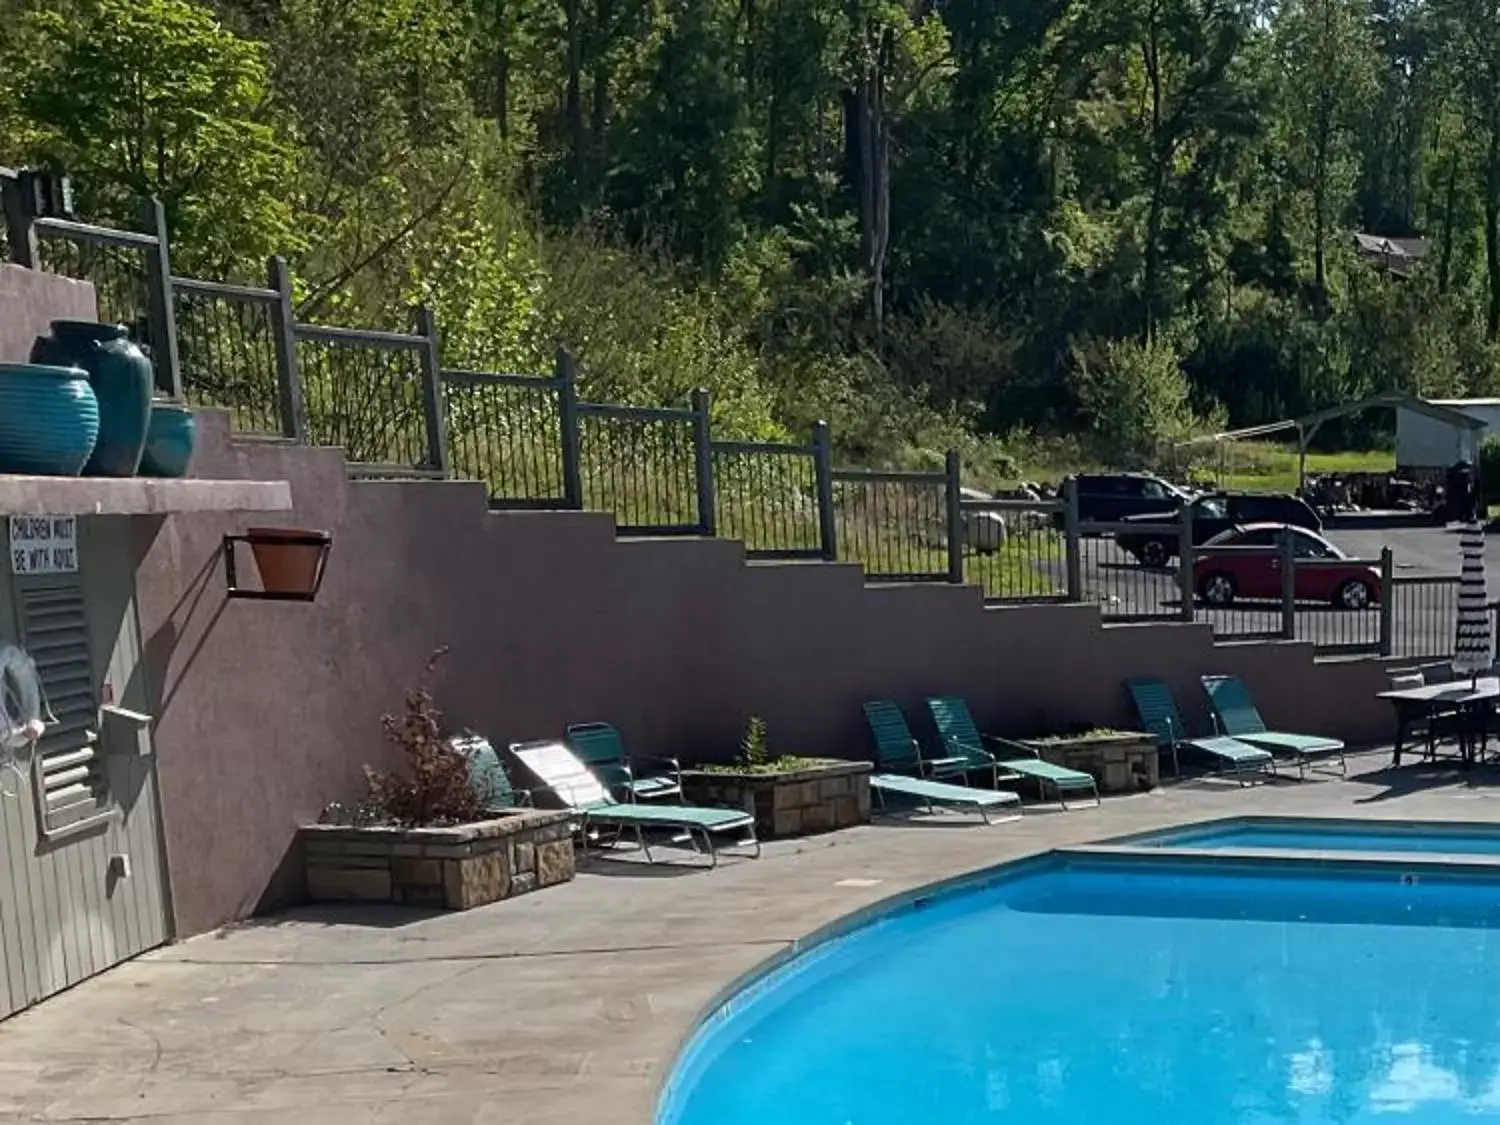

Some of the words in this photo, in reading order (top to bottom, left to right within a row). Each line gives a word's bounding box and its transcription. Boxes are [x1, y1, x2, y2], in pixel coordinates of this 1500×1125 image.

[13, 518, 51, 541] CHILDREN
[54, 519, 74, 540] MUST
[15, 549, 27, 572] BE
[28, 548, 50, 570] WITH
